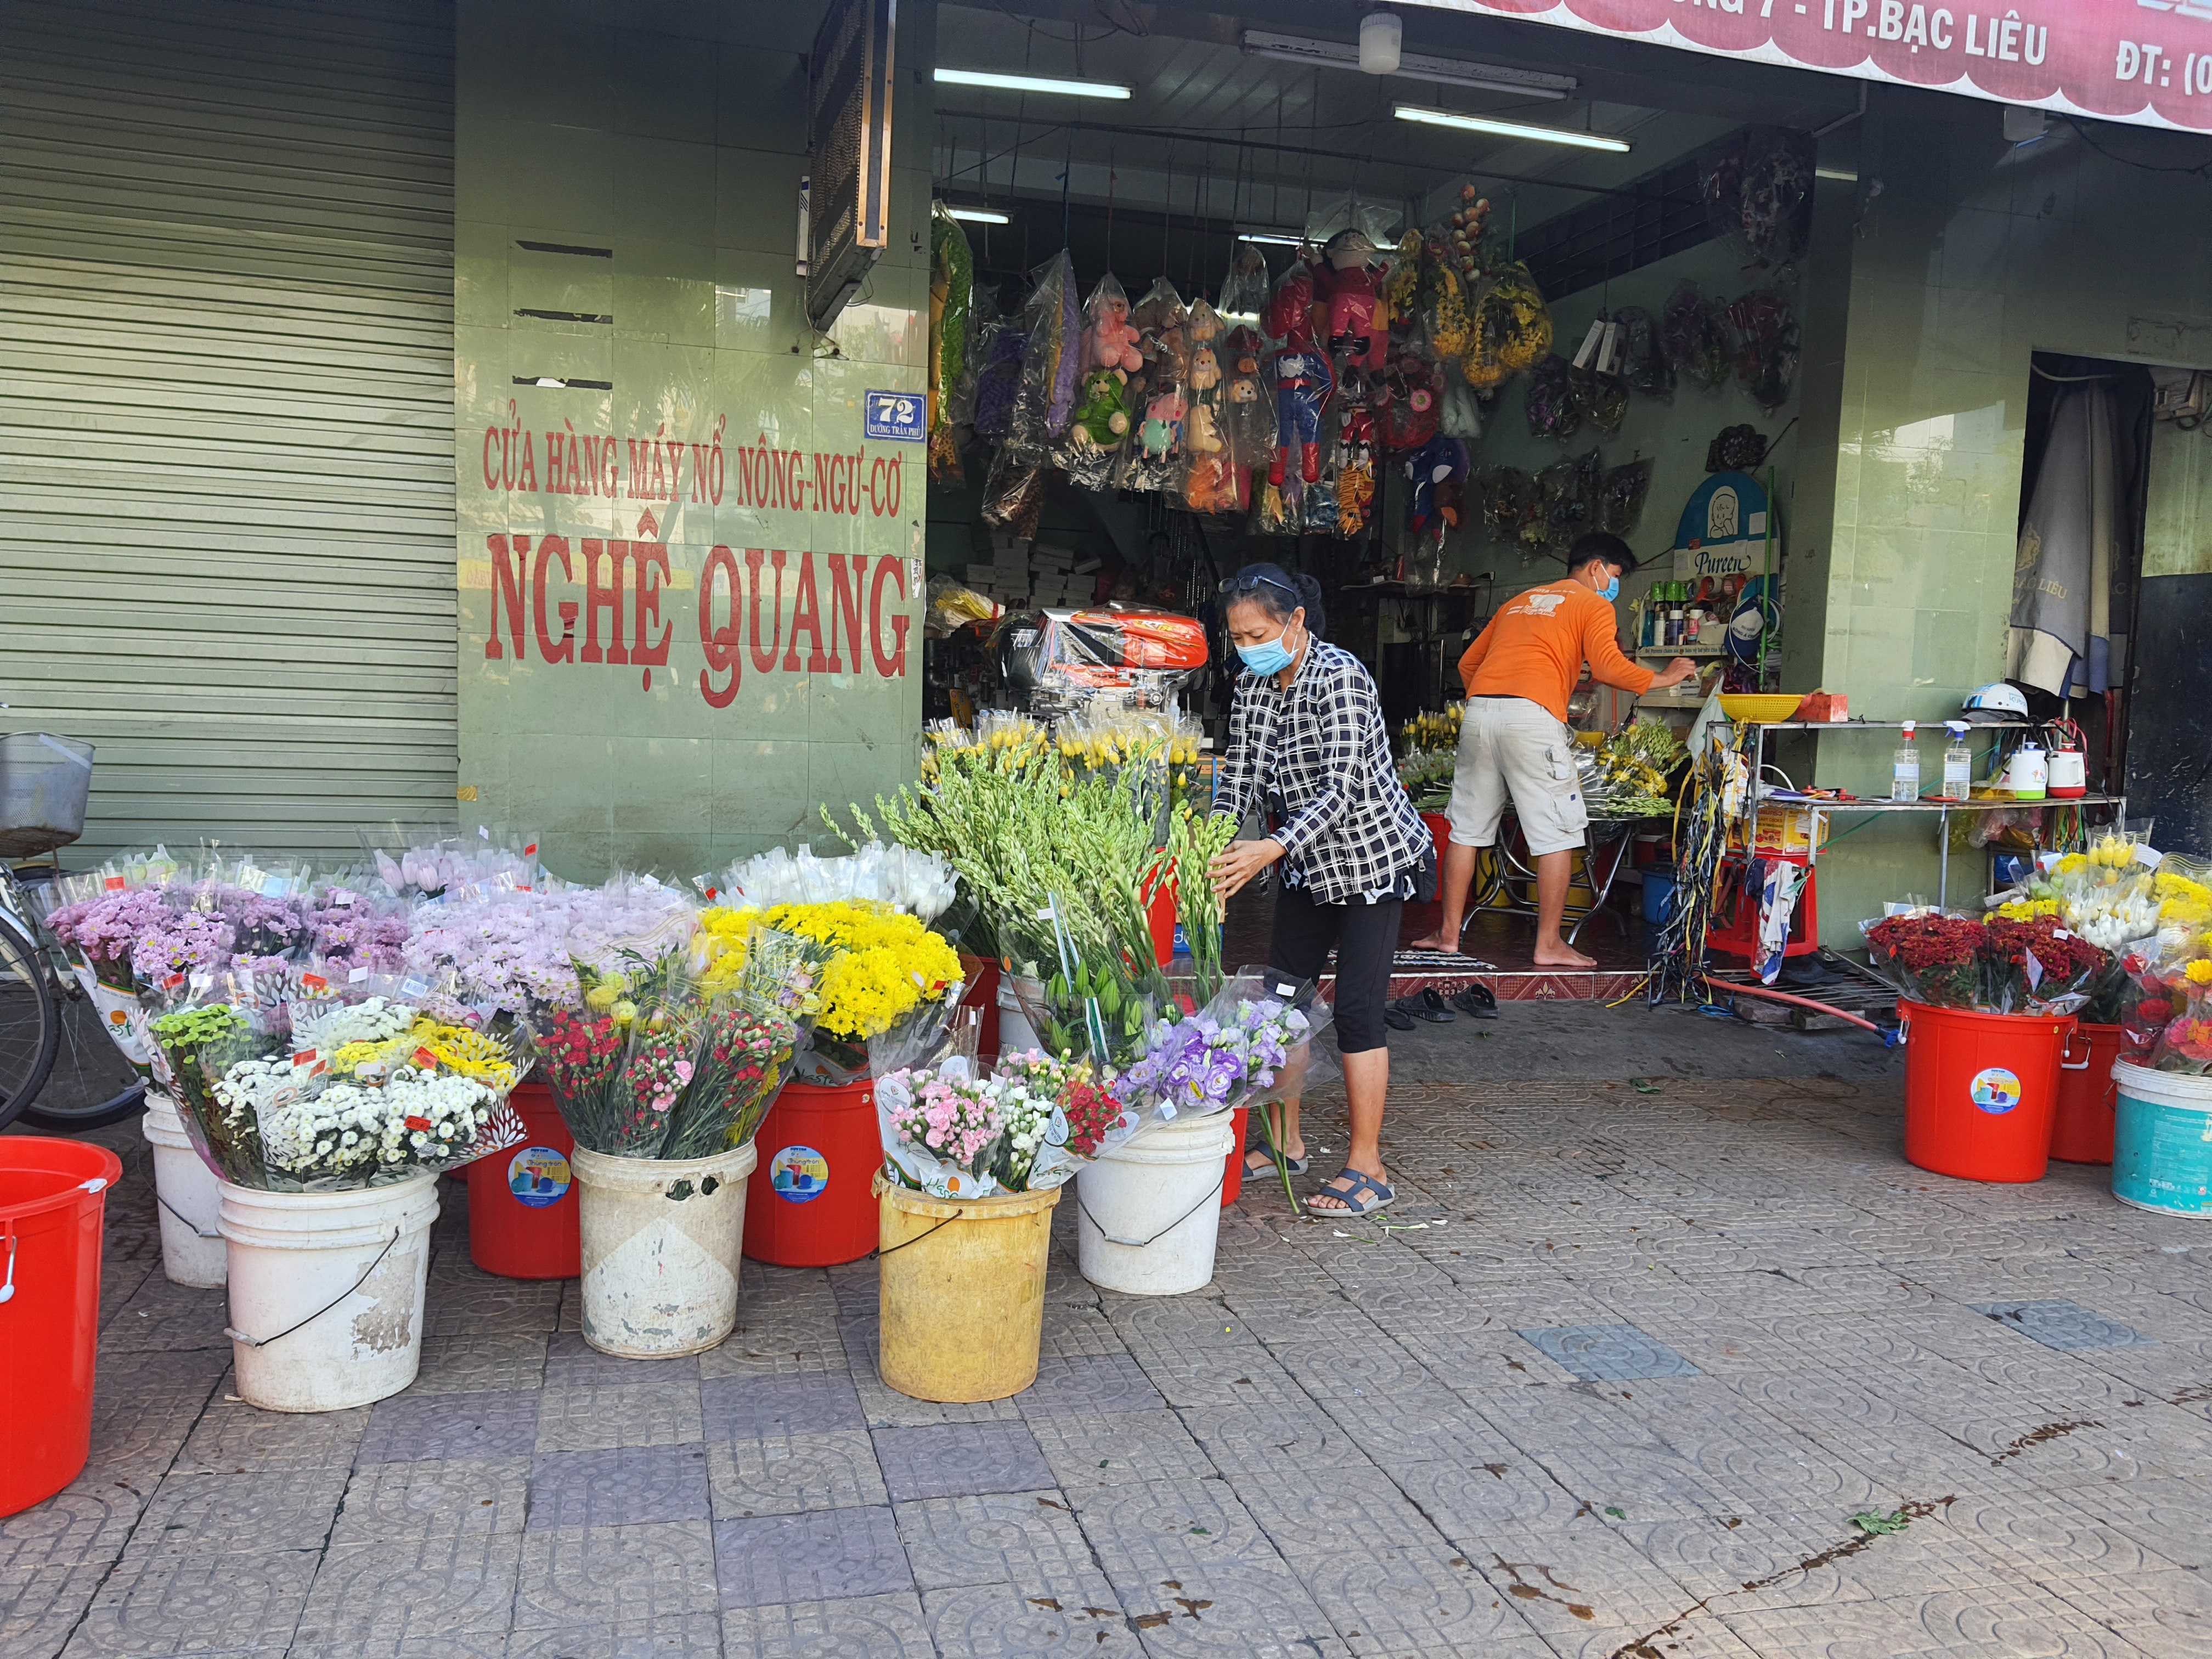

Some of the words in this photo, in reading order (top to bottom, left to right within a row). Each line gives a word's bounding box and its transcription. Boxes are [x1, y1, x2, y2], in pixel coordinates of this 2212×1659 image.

[1965, 10, 2047, 65] LIÊU
[2116, 40, 2171, 87] ĐT:
[878, 397, 914, 424] 72
[483, 398, 537, 492] CỬA
[545, 417, 619, 499] HÀNG
[627, 422, 684, 501] MÁY
[692, 413, 727, 505] NỔ
[1695, 551, 1751, 575] Pureen
[486, 507, 673, 692] NGHỆ
[698, 544, 909, 708] QUANG
[2038, 578, 2069, 599] LIÊU
